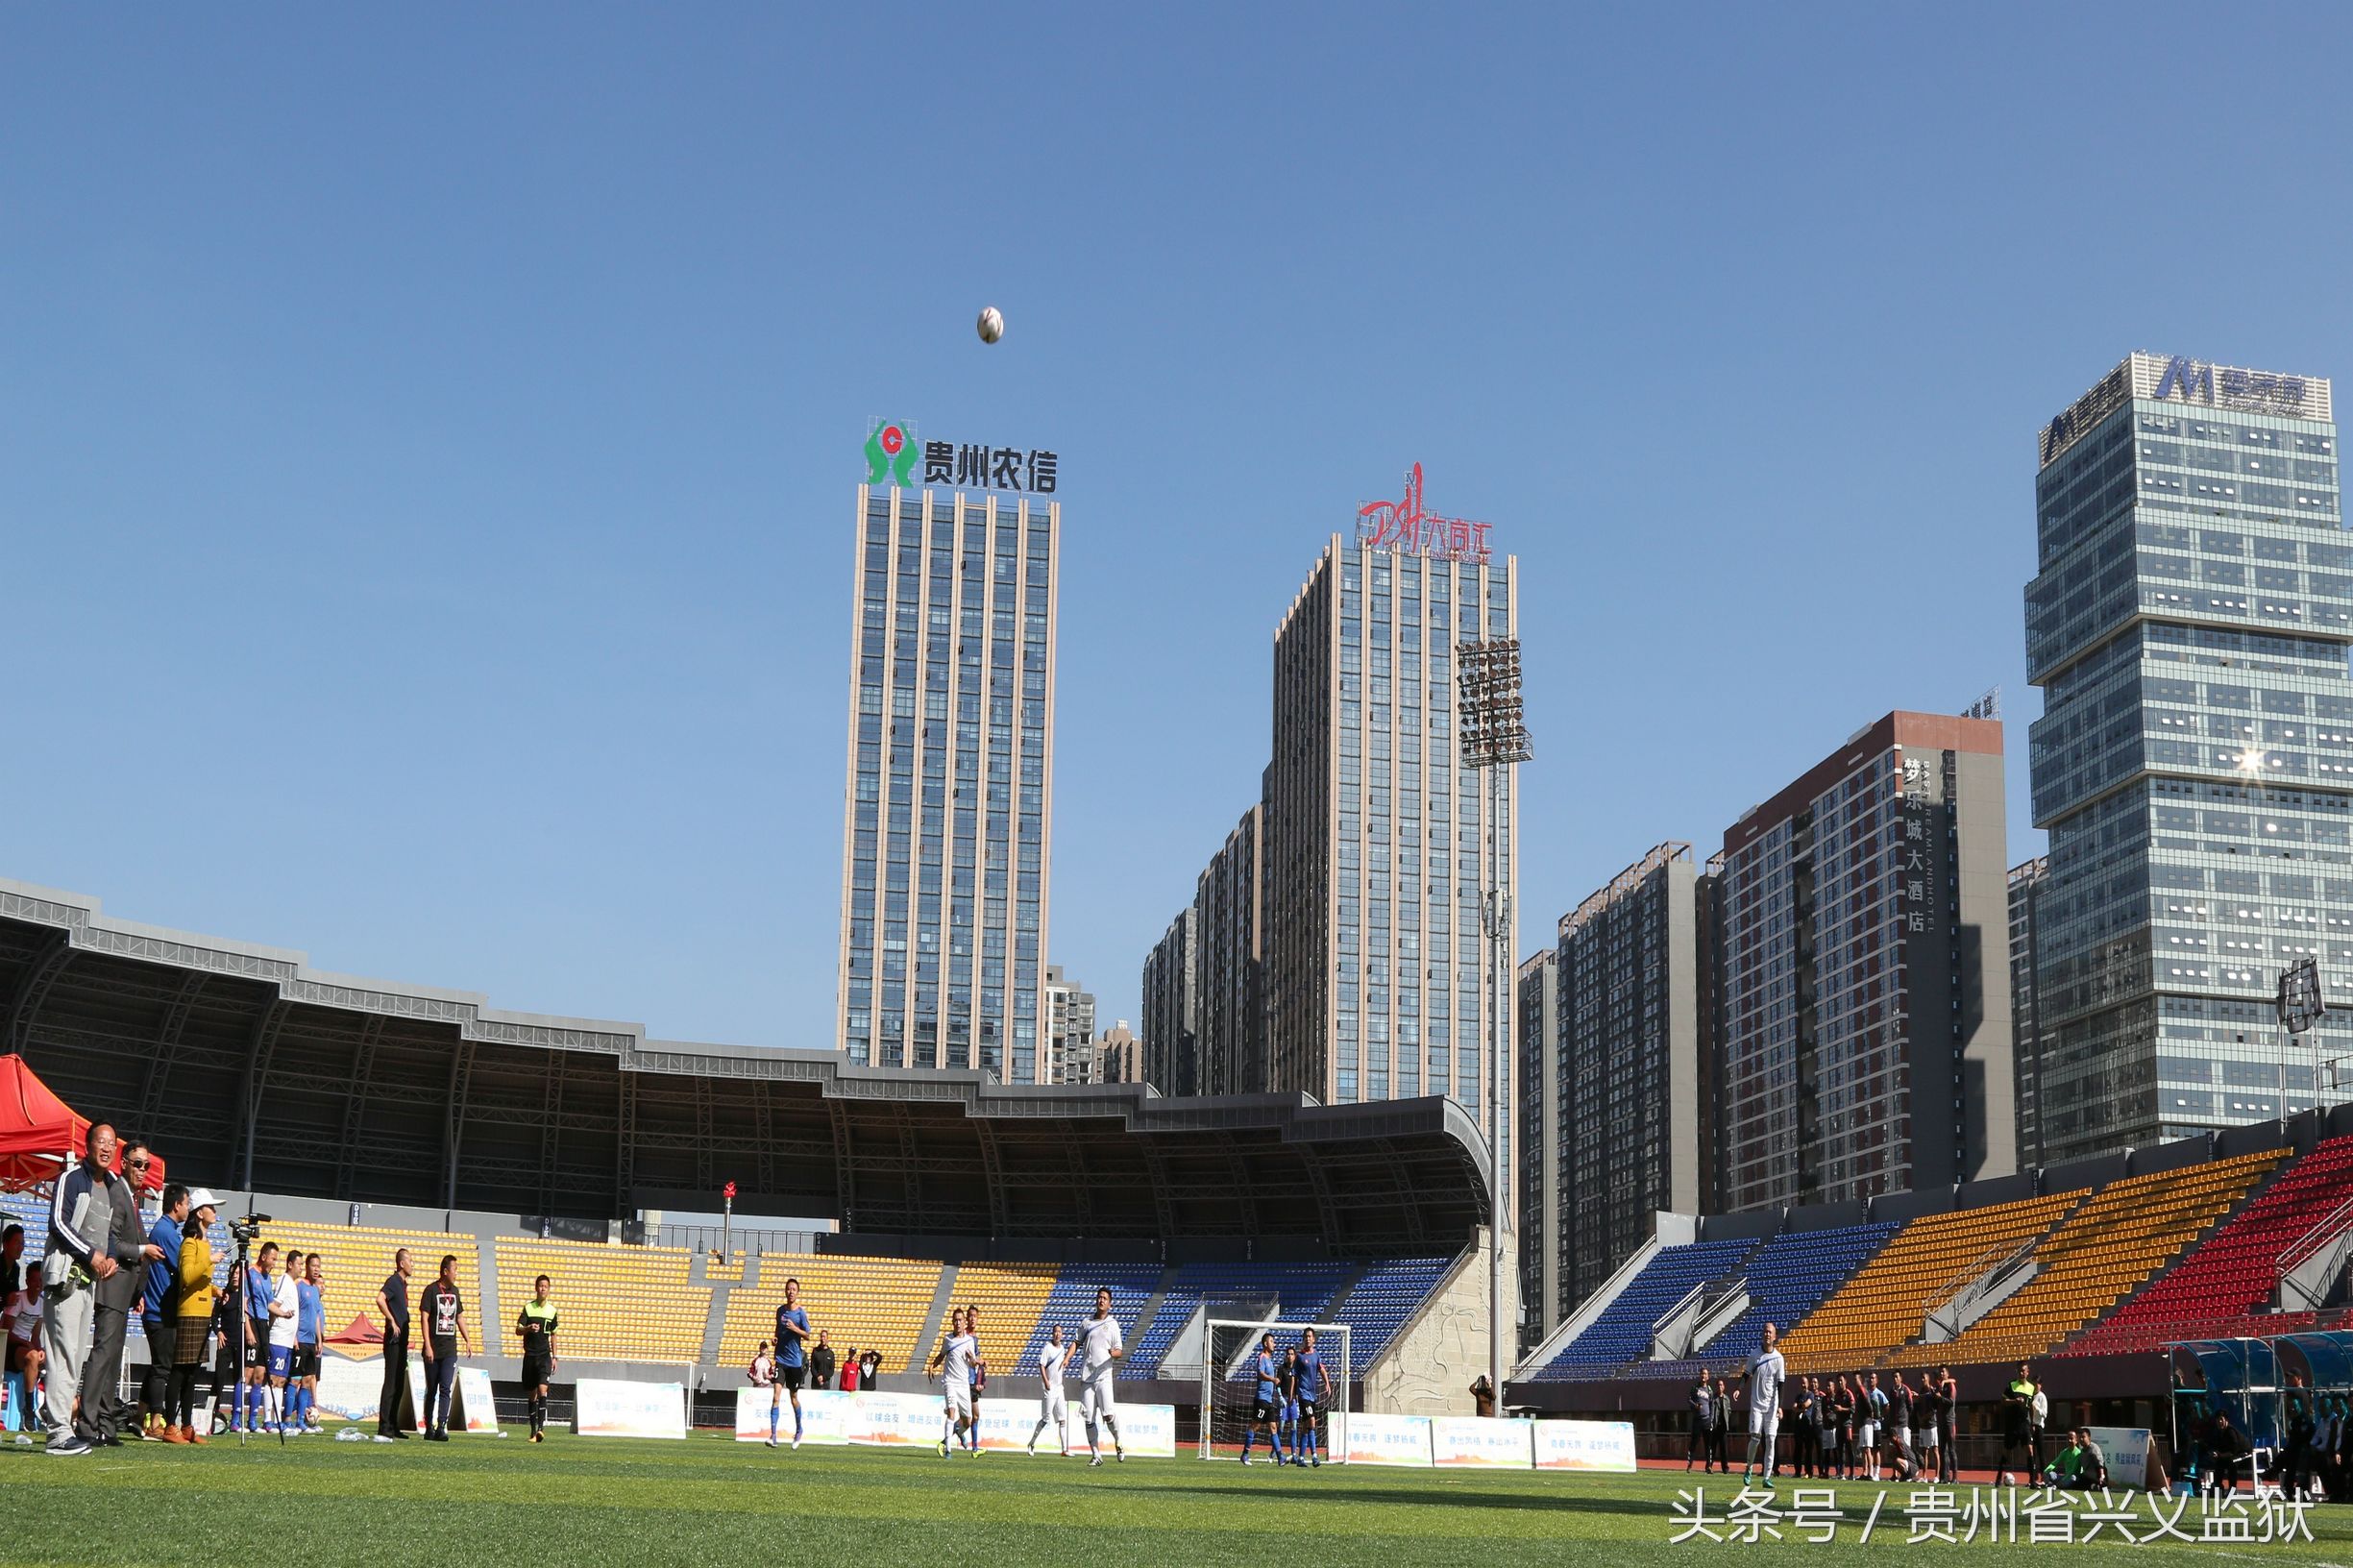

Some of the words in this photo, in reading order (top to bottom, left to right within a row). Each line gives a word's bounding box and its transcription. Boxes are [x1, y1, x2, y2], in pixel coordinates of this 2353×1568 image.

[924, 440, 1058, 493] 贵州农信
[1904, 758, 1924, 933] 梦乐城大酒店
[247, 1348, 257, 1361] 13
[275, 1357, 285, 1370] 20
[295, 1356, 301, 1368] 7
[1305, 1406, 1313, 1415] 10
[866, 1411, 900, 1423] 以球会友
[907, 1413, 943, 1426] 增进友谊
